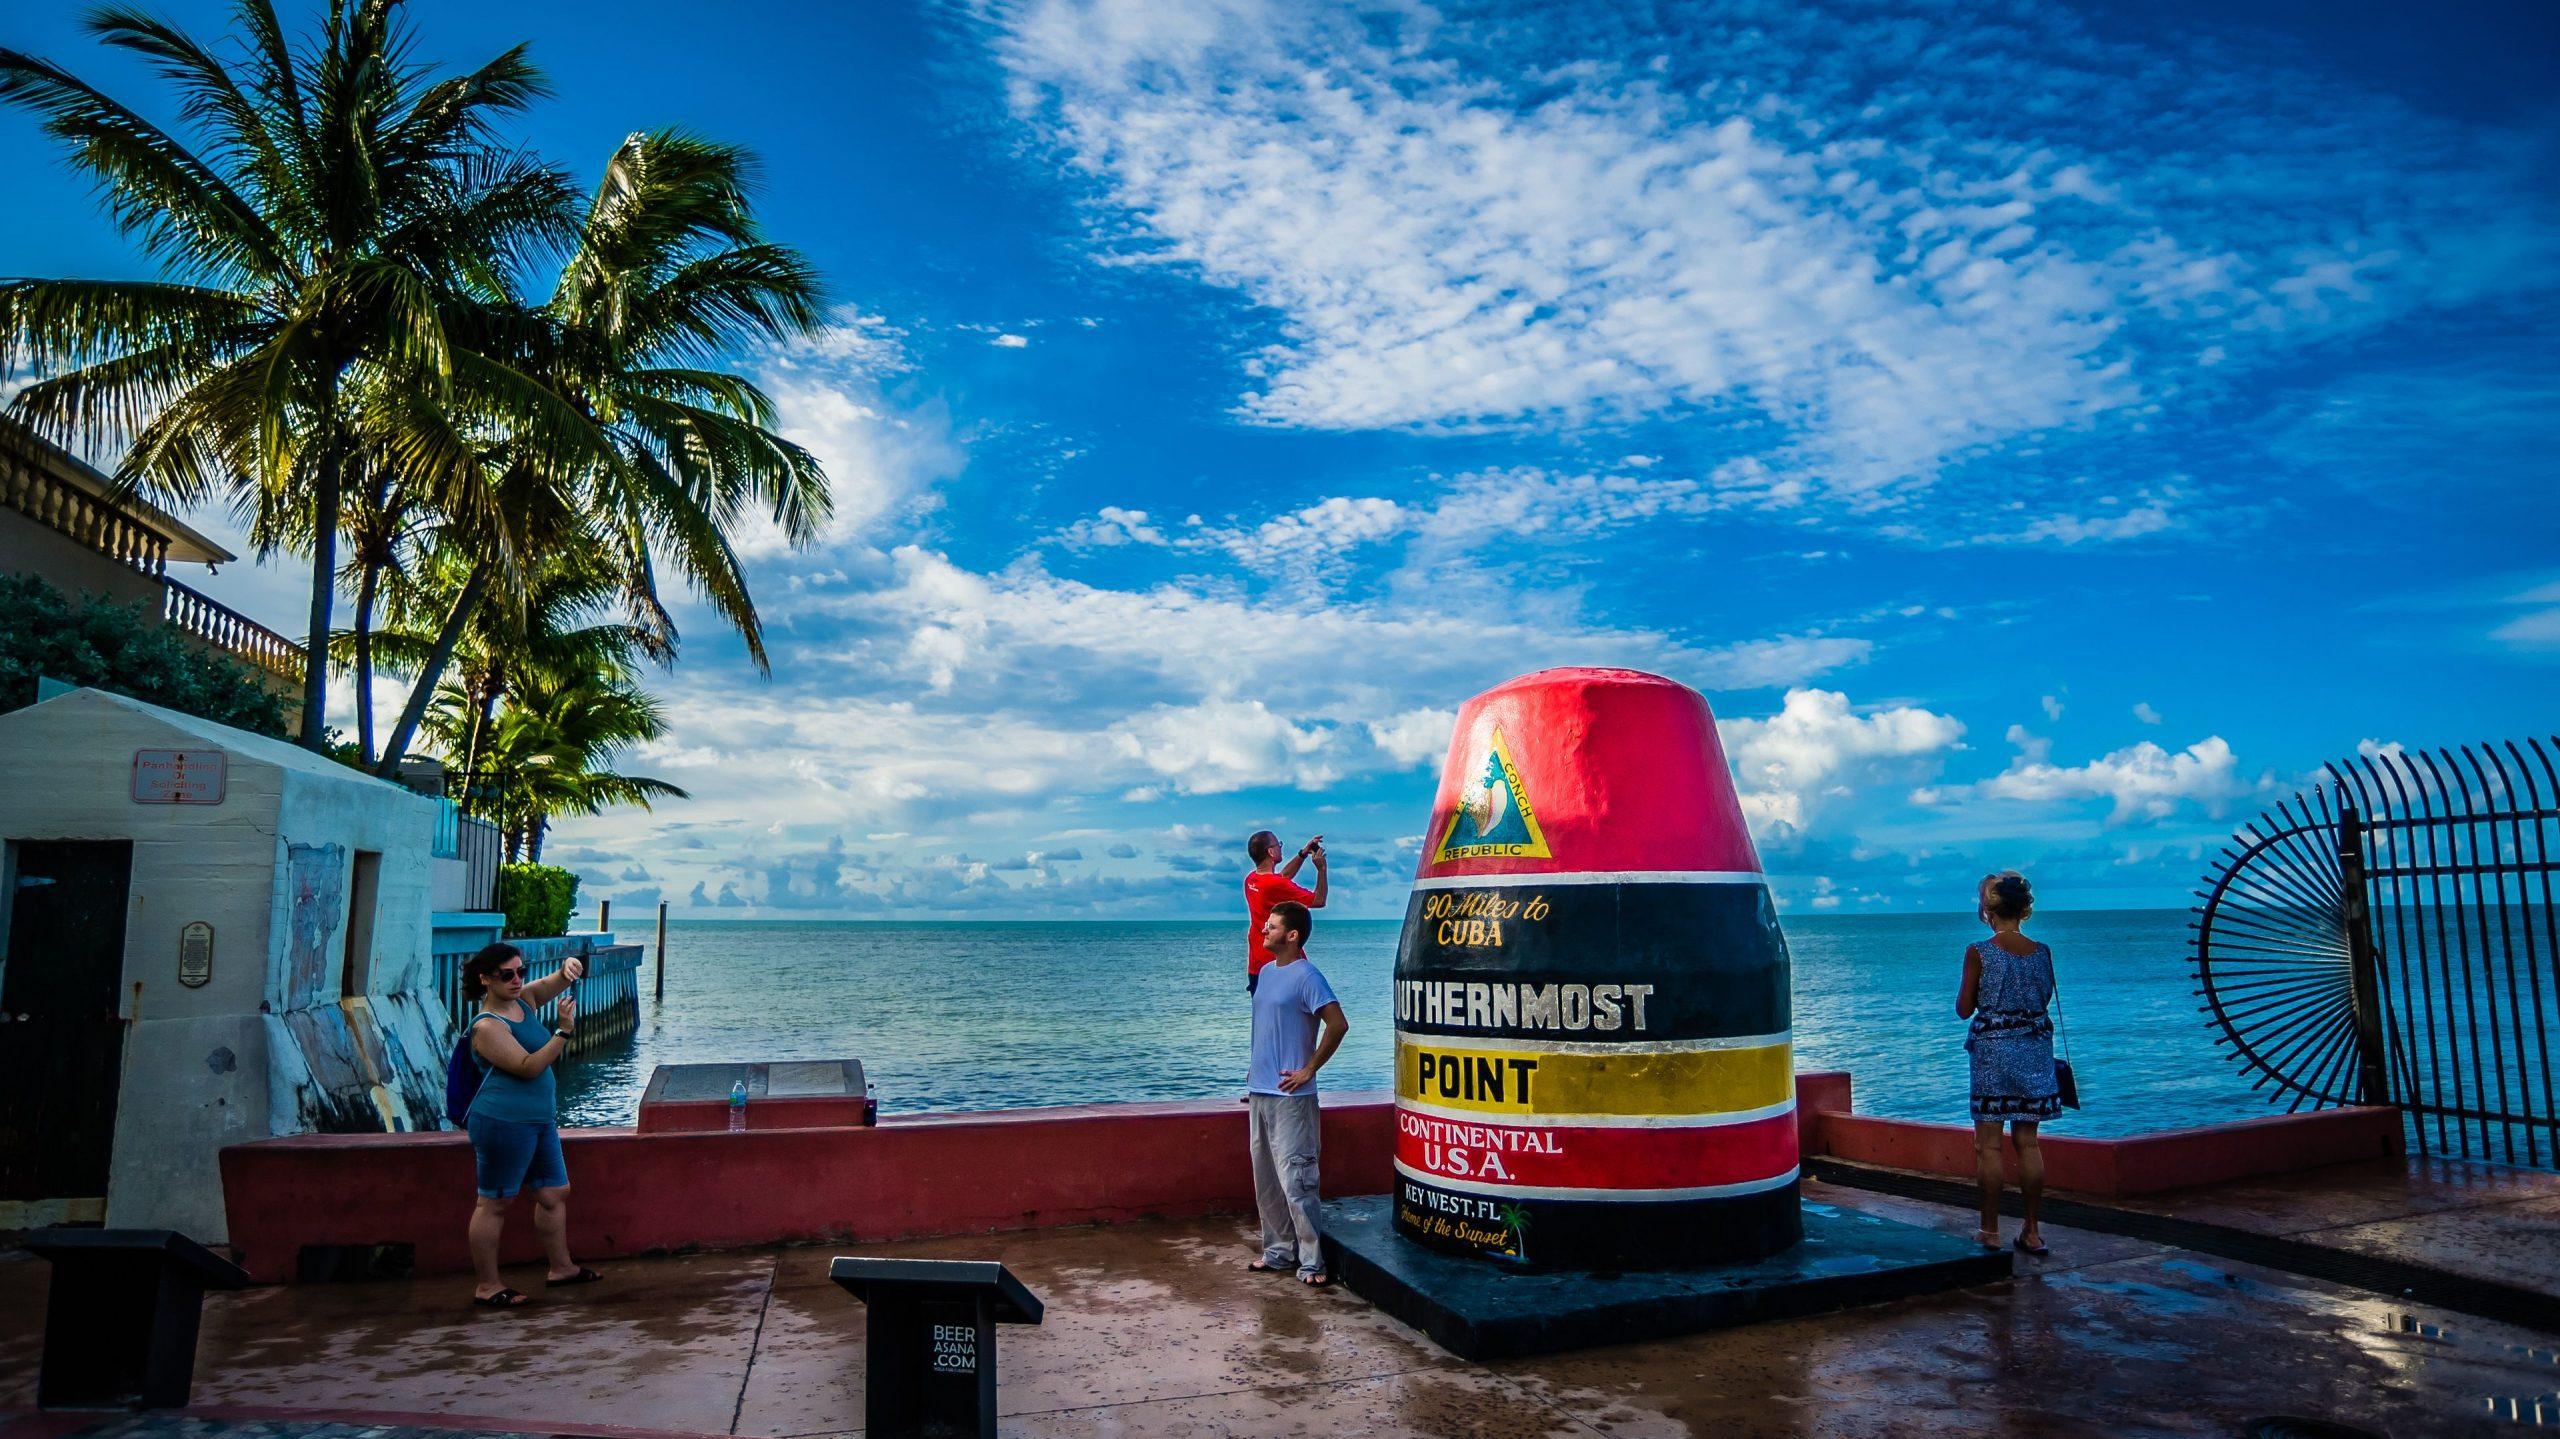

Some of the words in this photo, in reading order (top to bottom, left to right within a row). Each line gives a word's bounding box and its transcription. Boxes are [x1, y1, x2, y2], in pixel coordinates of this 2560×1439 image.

[1504, 763, 1533, 818] CONCH
[1444, 844, 1522, 860] REPUBLIC
[1424, 893, 1452, 920] 90
[1449, 892, 1520, 919] Miles
[1523, 895, 1550, 921] to
[1438, 920, 1503, 947] CUBA
[1395, 979, 1654, 1031] OUTHERNMOST
[1419, 1052, 1538, 1105] POINT
[1400, 1113, 1563, 1154] CONTINENTAL
[1424, 1142, 1516, 1180] U.S.A.
[1405, 1183, 1424, 1205] KEY
[1401, 1204, 1421, 1228] Home
[1423, 1216, 1434, 1234] of
[1434, 1217, 1451, 1237] the
[1455, 1221, 1508, 1246] Sunset
[934, 1325, 976, 1342] BEER
[934, 1341, 976, 1355] ASANA
[933, 1354, 976, 1368] .COM
